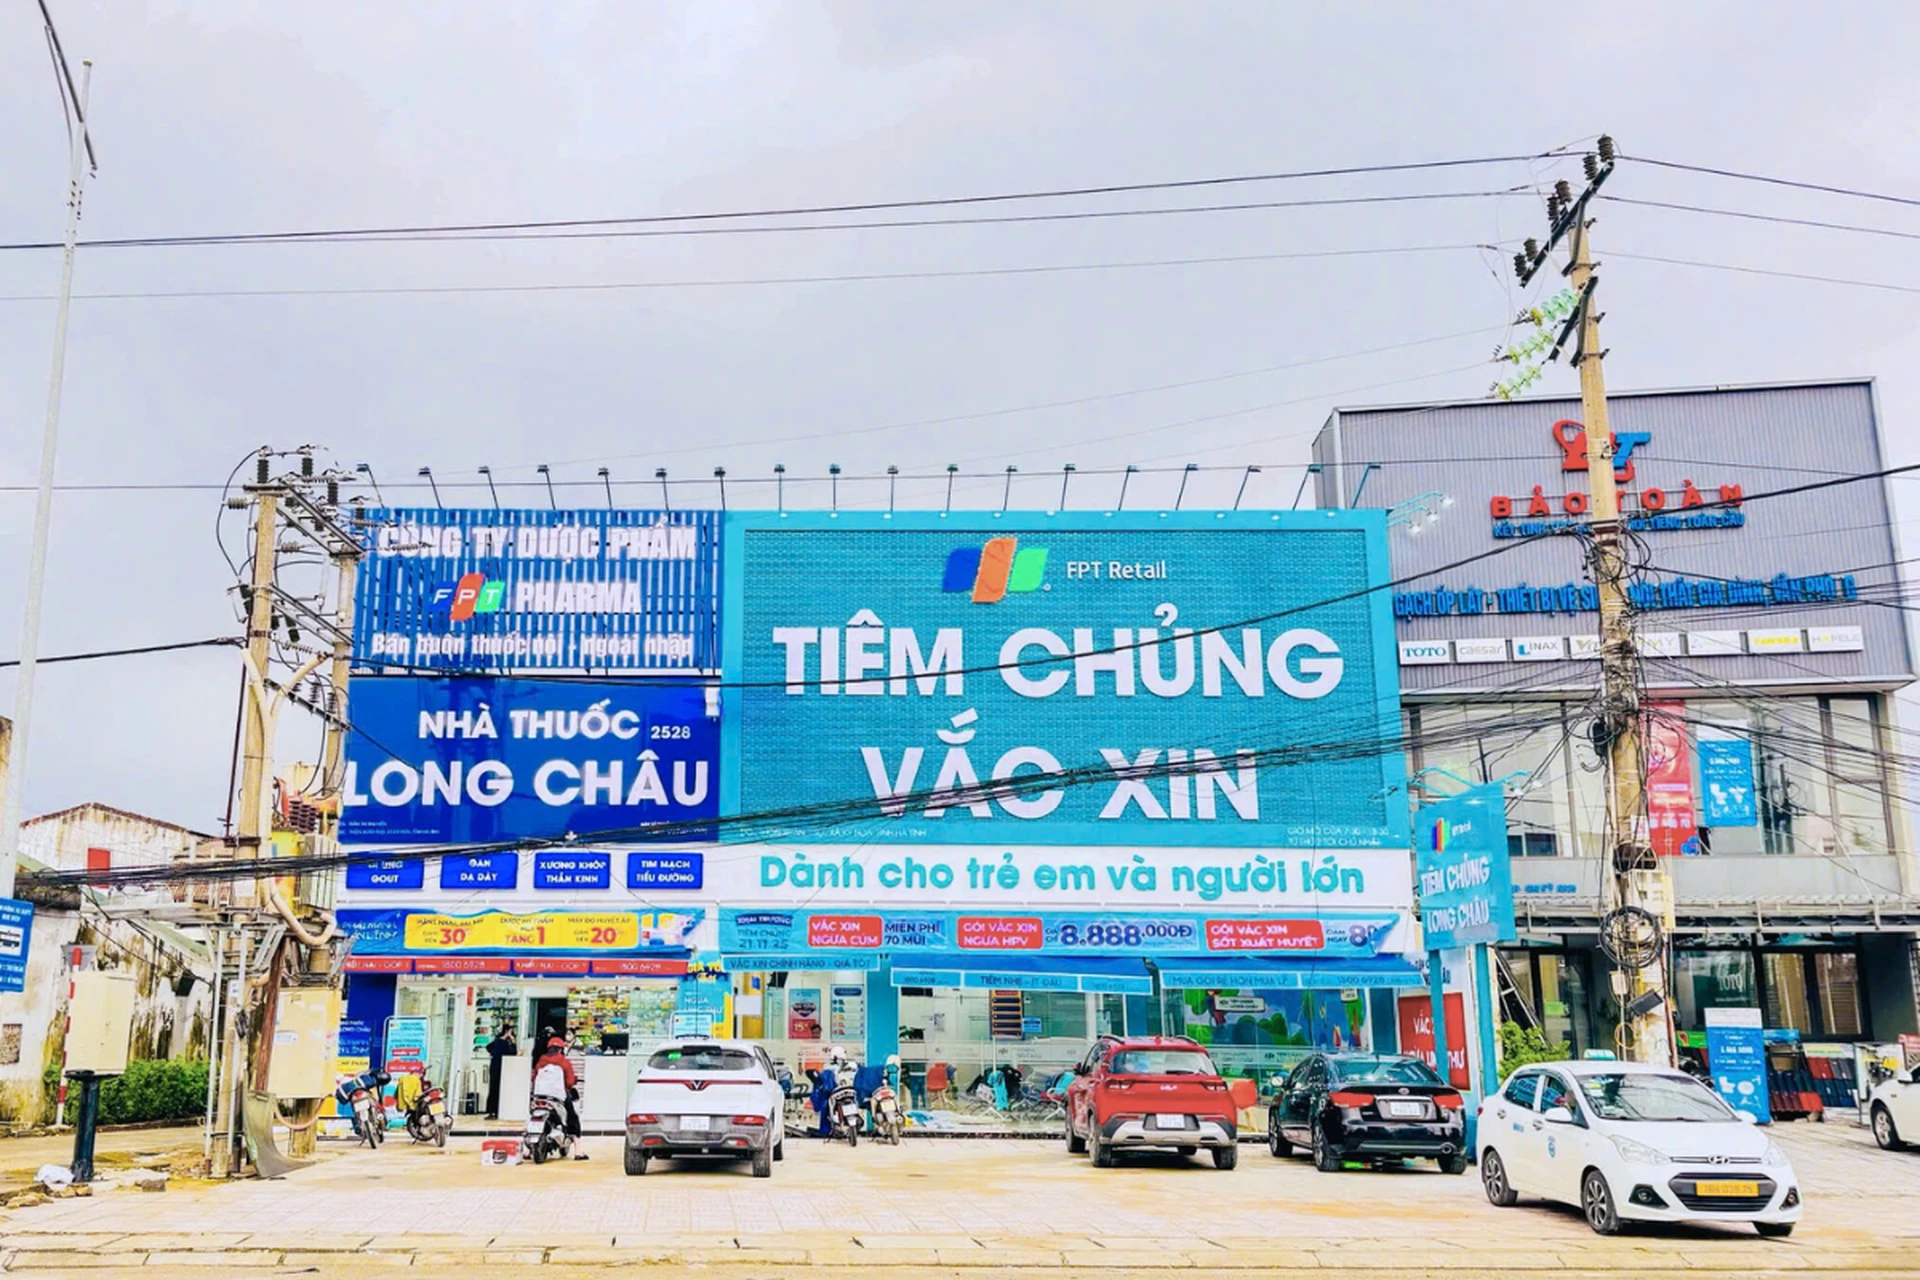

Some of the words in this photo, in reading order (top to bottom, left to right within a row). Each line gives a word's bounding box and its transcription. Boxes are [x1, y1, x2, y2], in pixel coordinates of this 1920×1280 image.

[1491, 484, 1588, 518] BẢO
[472, 527, 510, 558] TY
[518, 523, 600, 563] DƯỢC
[606, 517, 697, 558] PHẨM
[1066, 561, 1101, 579] FPT
[1108, 559, 1167, 579] Retail
[516, 583, 642, 613] PHARMA
[1698, 581, 1723, 605] GIA
[1395, 590, 1431, 624] GẠCH
[1437, 584, 1455, 614] ỐP
[1558, 582, 1577, 617] VỆ
[1579, 587, 1598, 611] SI
[773, 608, 964, 696] TIÊM
[1000, 602, 1344, 700] CHỦNG
[1403, 646, 1447, 658] TOTO
[1459, 644, 1504, 656] caesar
[1528, 641, 1558, 651] INAX
[418, 702, 498, 739] NHÀ
[510, 698, 640, 740] THUỐC
[651, 725, 692, 740] 2528
[860, 707, 1064, 820] VẮC
[1099, 748, 1261, 820] XIN
[343, 759, 514, 807] LONG
[533, 749, 709, 807] CHÂU
[641, 860, 657, 868] TIM
[660, 860, 690, 870] MẠCH
[371, 874, 399, 883] GOUT
[575, 874, 598, 883] KINH
[760, 852, 865, 889] Dành
[878, 857, 954, 890] cho
[967, 852, 1020, 890] trẻ
[1033, 864, 1096, 892] em
[1106, 854, 1157, 892] và
[1172, 854, 1287, 901] người
[1302, 855, 1365, 893] lớn
[1421, 866, 1446, 897] TIÊM
[1446, 853, 1490, 891] CHỦNG
[1427, 905, 1456, 933] LONG
[1457, 895, 1490, 928] CHÂU
[811, 917, 836, 932] VẮC
[840, 921, 861, 931] XIN
[884, 918, 916, 933] MIỄN
[918, 920, 940, 933] PHÍ
[988, 918, 1013, 932] VẮC
[1017, 922, 1037, 932] XIN
[1237, 922, 1263, 936] VẮC
[1266, 924, 1288, 935] XIN
[536, 926, 546, 945] 1
[850, 934, 878, 945] CÚM
[884, 934, 899, 945] 70
[1002, 936, 1028, 946] HPV
[730, 958, 750, 969] VẮC
[752, 959, 767, 968] XIN
[769, 958, 797, 968] CHÍNH
[799, 958, 826, 968] HÀNG
[980, 975, 1002, 985] TIÊM
[1172, 976, 1193, 985] MUA
[1254, 976, 1275, 985] MUA
[1360, 976, 1385, 984] 6928
[1413, 1009, 1431, 1036] VẮC
